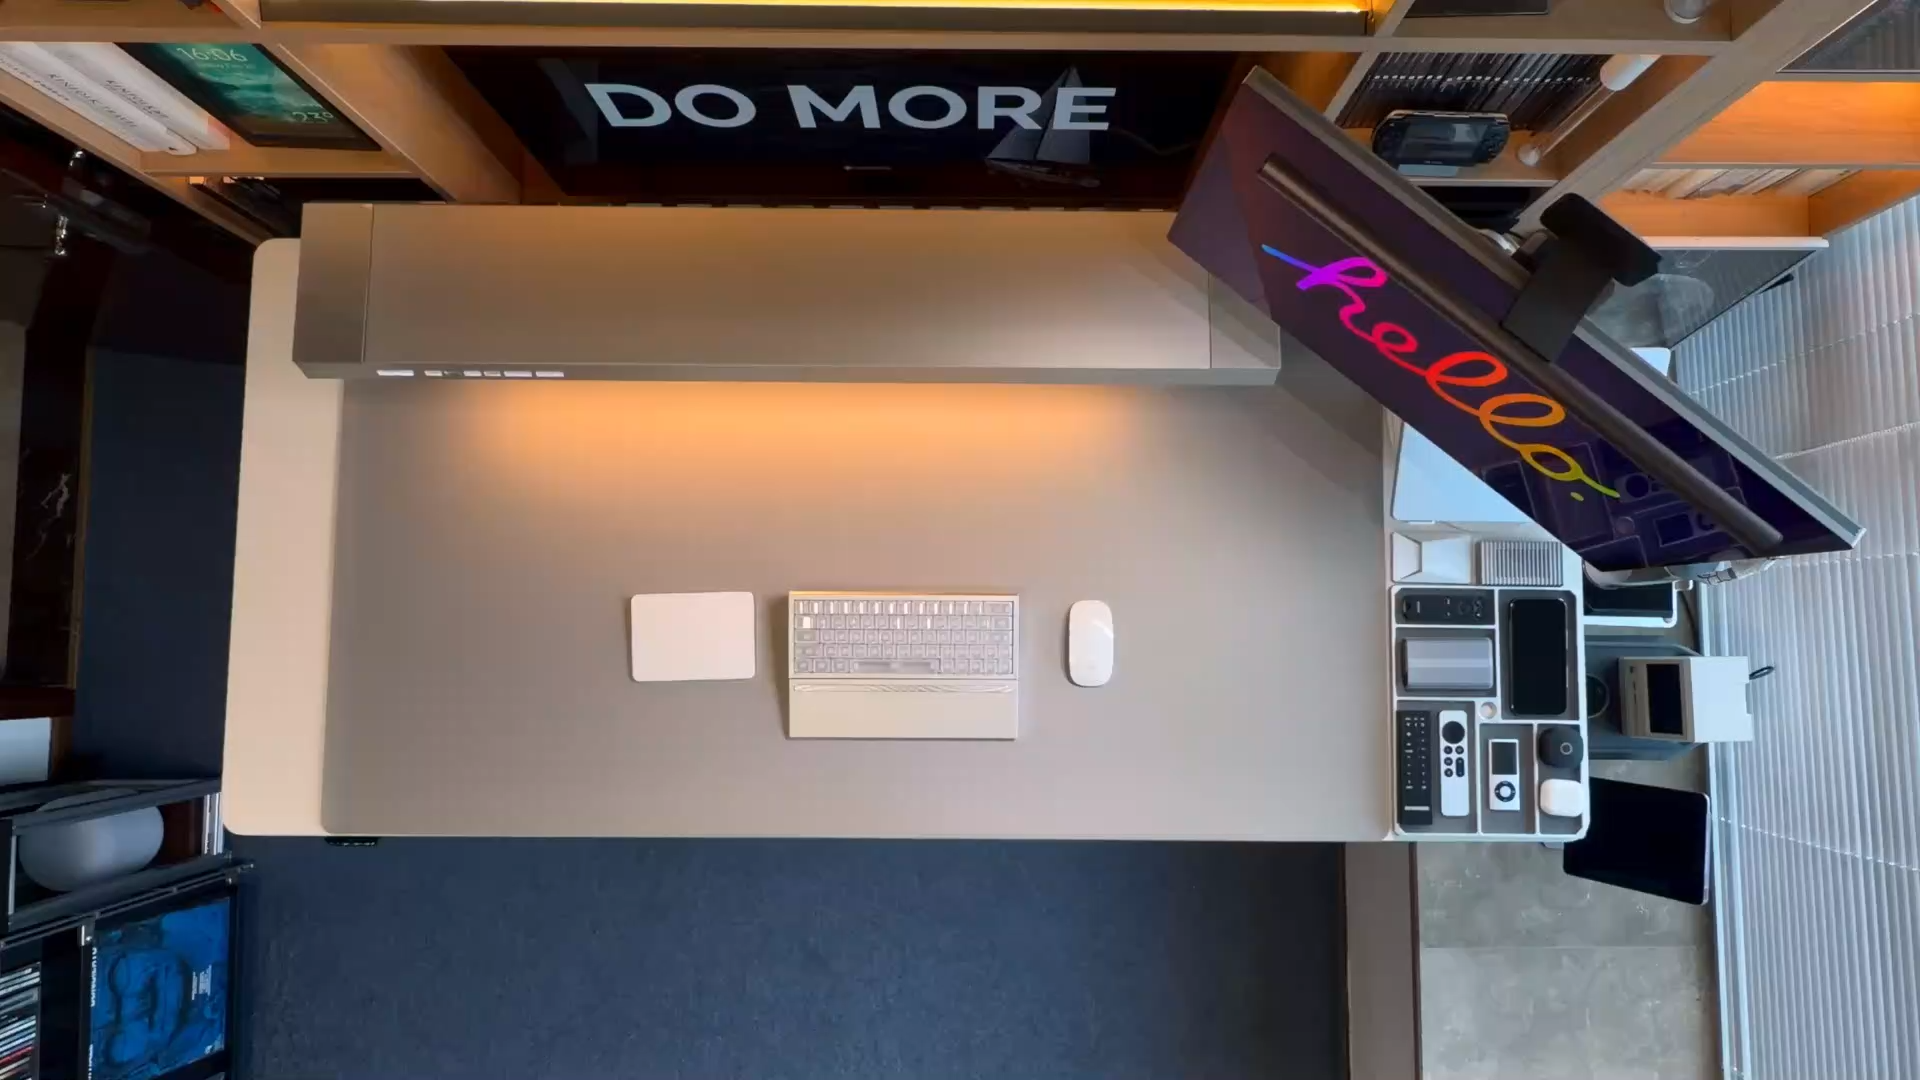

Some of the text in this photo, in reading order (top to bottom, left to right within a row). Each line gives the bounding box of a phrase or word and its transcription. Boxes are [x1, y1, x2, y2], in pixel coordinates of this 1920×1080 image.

[176, 47, 248, 62] 16:06
[584, 83, 1117, 131] DO MORE
